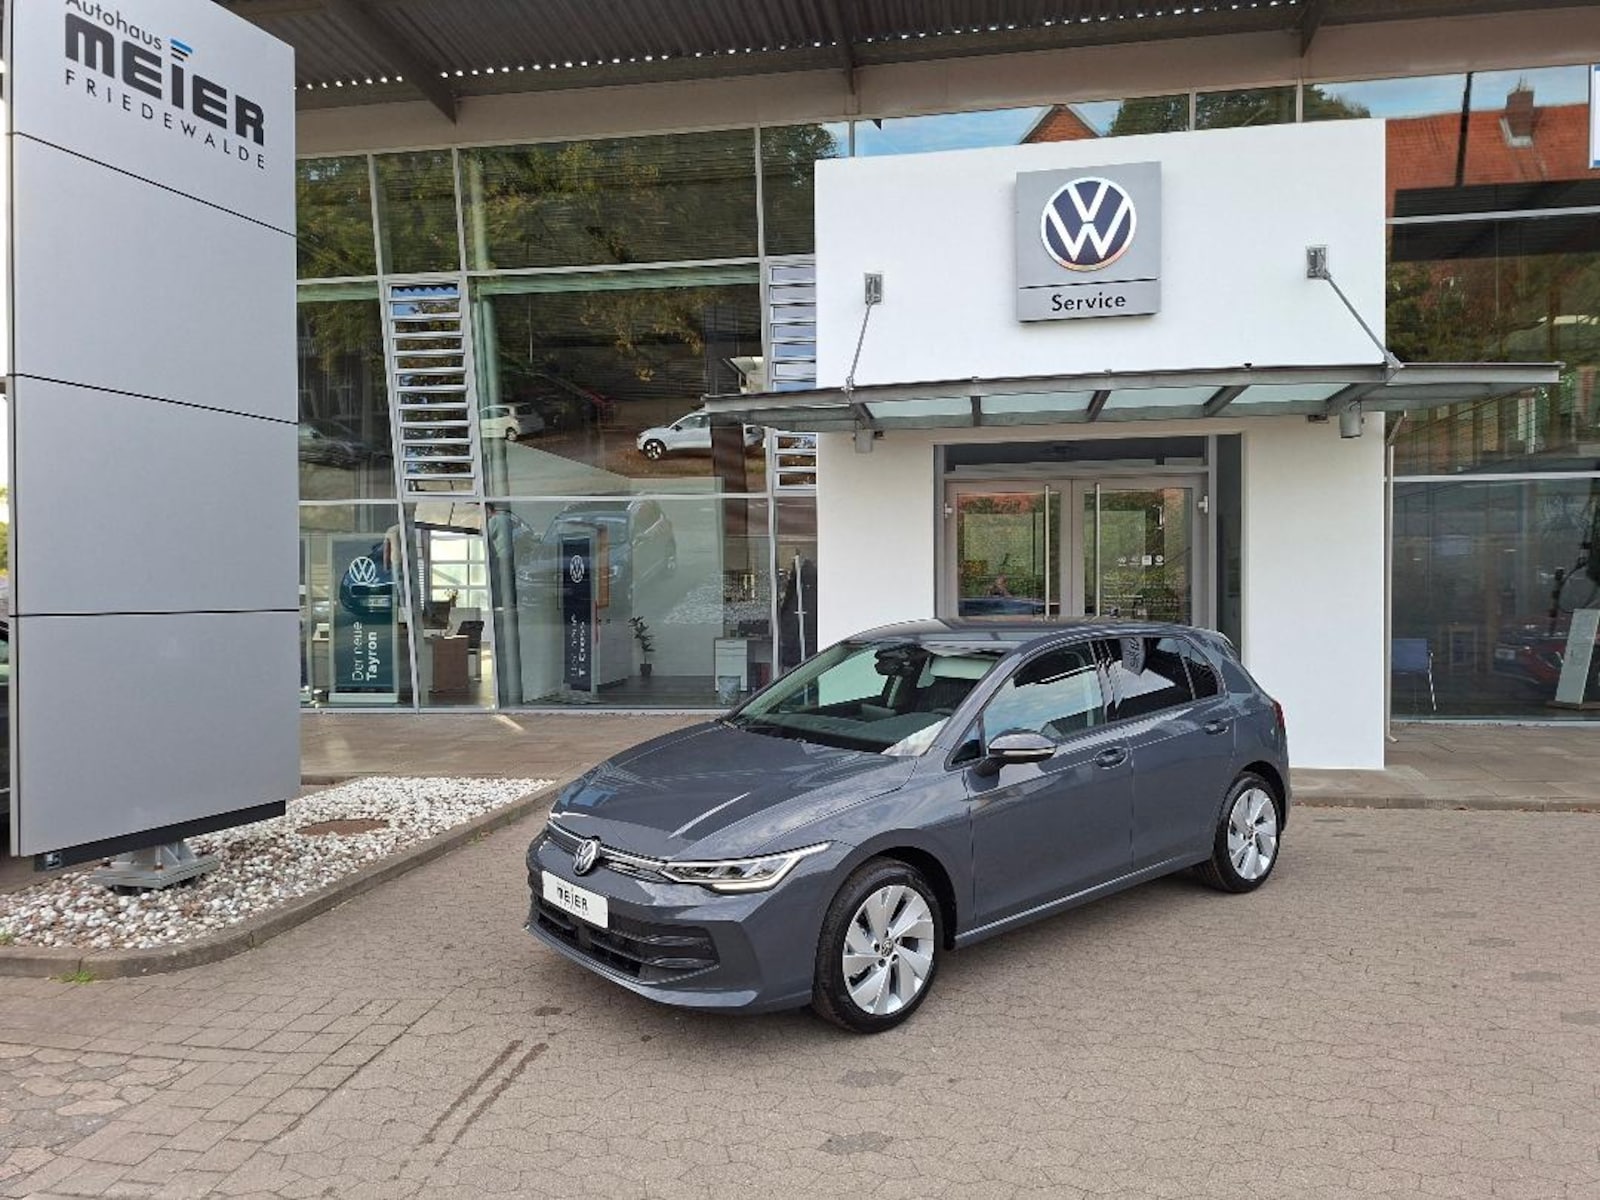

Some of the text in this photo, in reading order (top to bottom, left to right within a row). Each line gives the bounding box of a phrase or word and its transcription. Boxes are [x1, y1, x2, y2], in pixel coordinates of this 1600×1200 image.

[65, 13, 264, 146] MEIER
[65, 69, 265, 169] FRIEDEWALDE
[1052, 292, 1126, 311] Service
[352, 621, 363, 681] Der neue
[366, 631, 380, 681] Tayron
[578, 621, 586, 677] TCross
